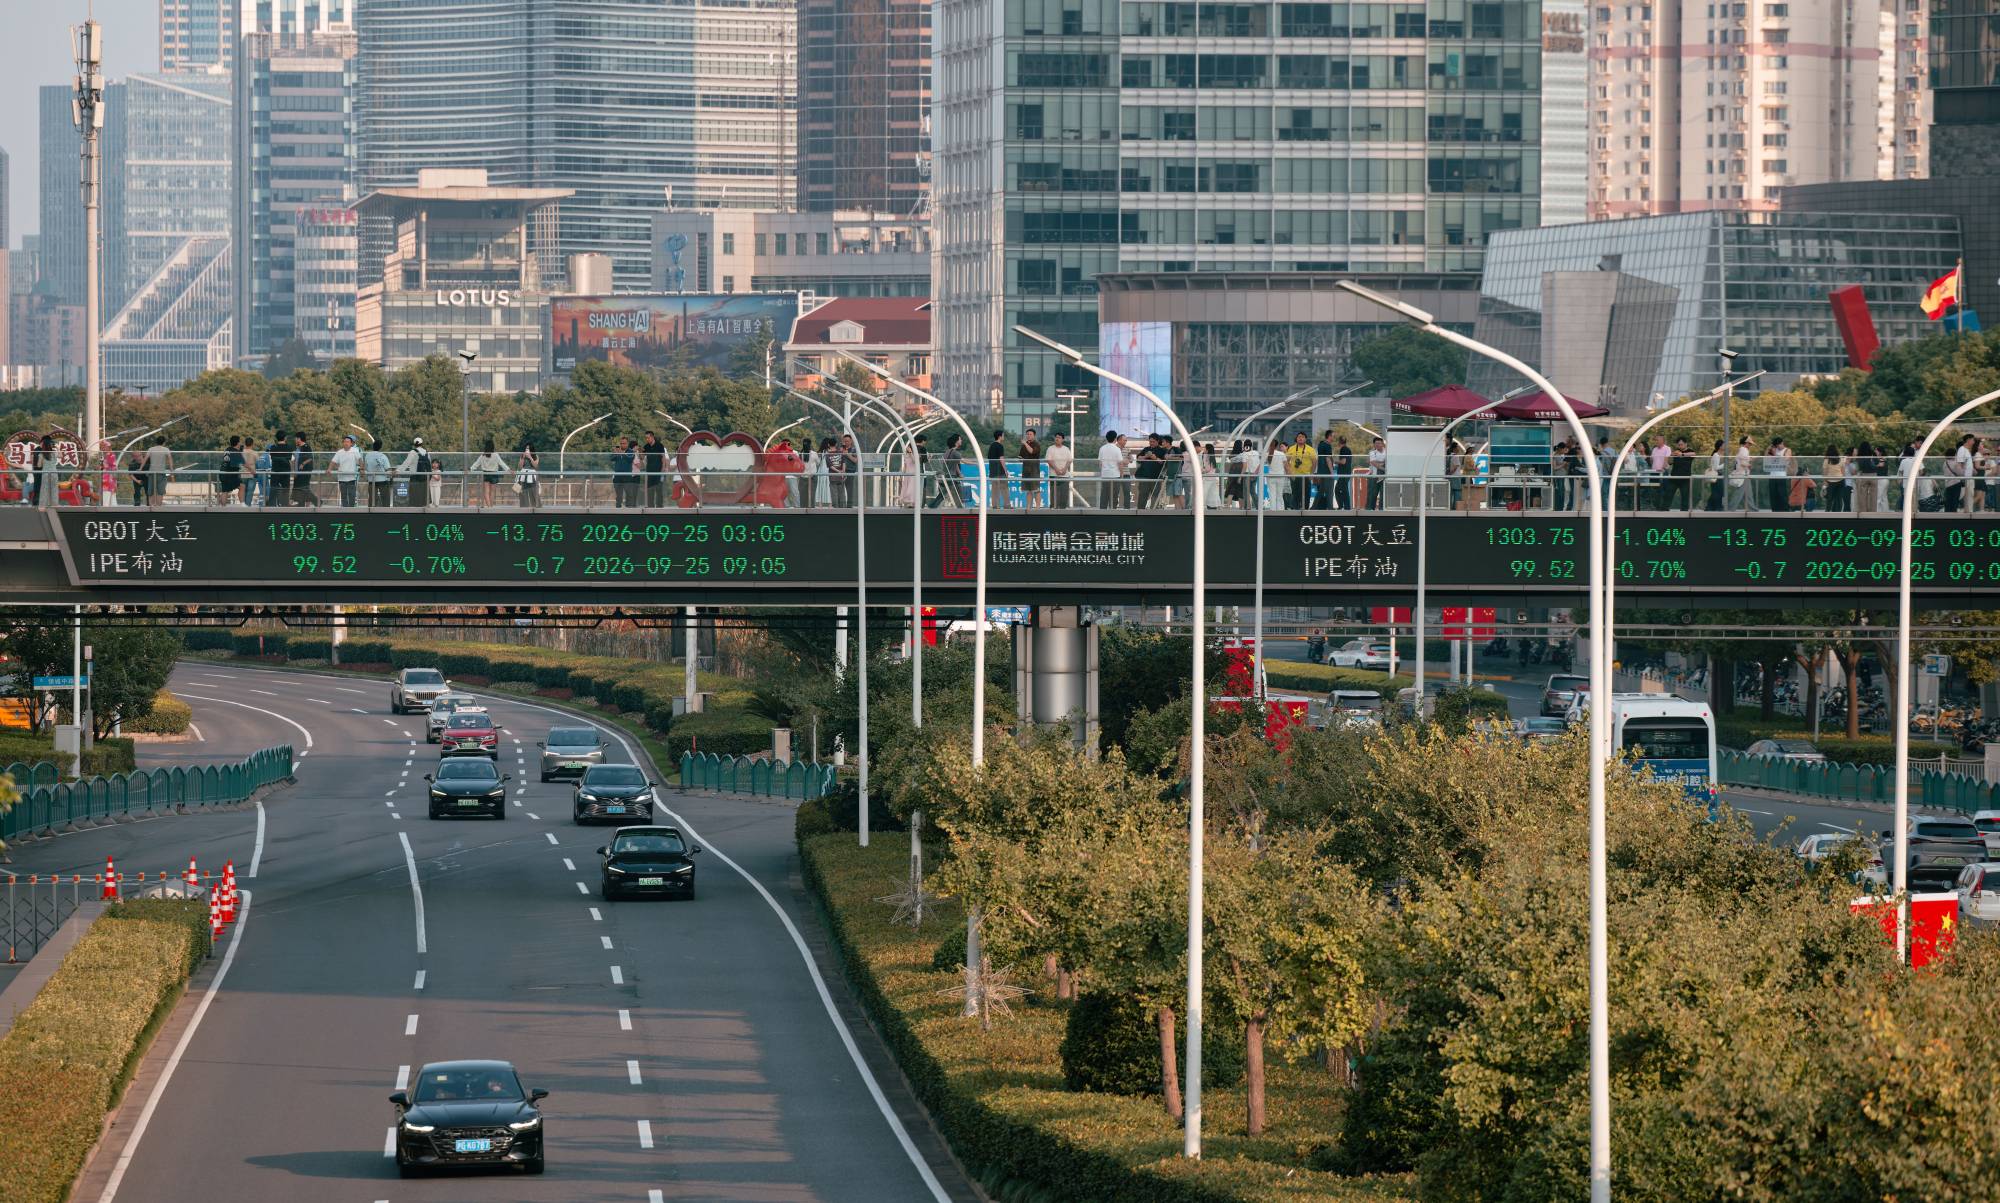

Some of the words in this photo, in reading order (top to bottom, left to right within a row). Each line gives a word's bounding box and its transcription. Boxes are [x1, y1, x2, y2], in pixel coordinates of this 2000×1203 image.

[437, 289, 510, 306] LOTUS
[589, 313, 626, 329] SHANG
[268, 522, 357, 543] 1303.75
[384, 522, 466, 544] -1.04%
[483, 522, 565, 543] -13.75
[580, 521, 710, 544] 2026-09-25
[720, 522, 786, 544] 03:05
[992, 531, 1145, 551] 陆家嘴金融城
[1485, 526, 1576, 546] 1303.75
[1708, 527, 1788, 548] -13.75
[1805, 527, 1937, 549] 2026-09-25
[292, 554, 358, 575] 99.52
[388, 554, 467, 576] -0.70%
[514, 555, 567, 576] -0.7
[582, 554, 711, 577] 2026-09-25
[722, 554, 787, 577] 09:05
[992, 553, 1047, 564] LUJIAZUI
[1049, 553, 1114, 565] FINANCIAL
[1116, 553, 1145, 566] CITY
[1509, 558, 1576, 580] 99.52
[1735, 559, 1788, 581] -0.7
[1805, 559, 1937, 582] 2026-09-25
